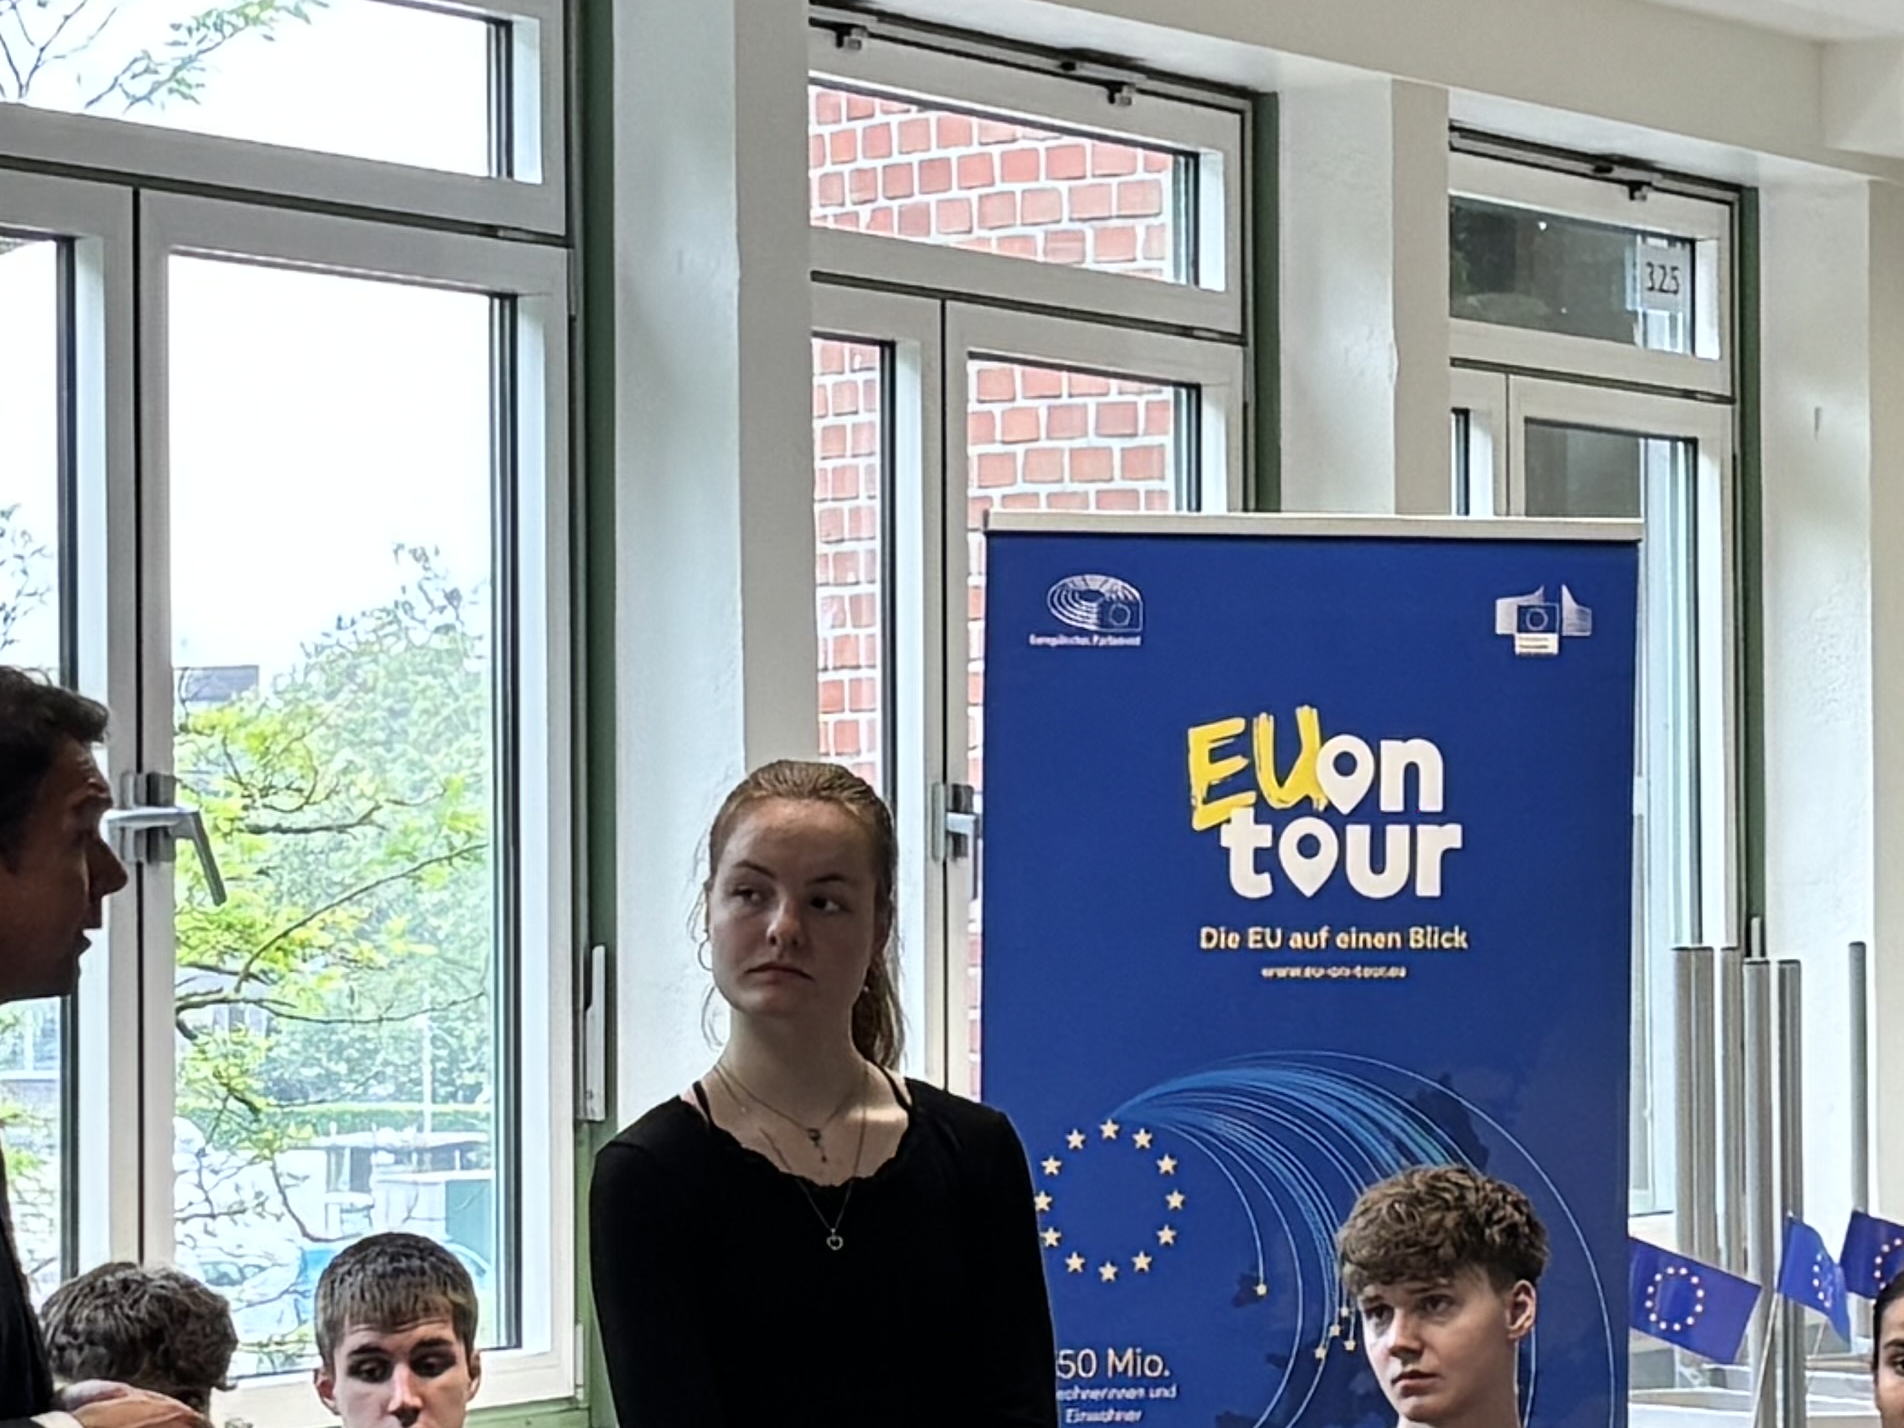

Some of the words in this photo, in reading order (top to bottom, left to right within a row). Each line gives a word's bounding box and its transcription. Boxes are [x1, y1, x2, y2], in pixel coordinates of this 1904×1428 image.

[1188, 705, 1327, 830] EU
[1315, 734, 1443, 815] on
[1220, 807, 1462, 897] tour
[1200, 926, 1240, 949] Die
[1248, 926, 1282, 949] EU
[1289, 925, 1330, 949] auf
[1336, 926, 1402, 949] einen
[1408, 925, 1468, 949] Blick
[1056, 1348, 1097, 1379] 50
[1107, 1347, 1171, 1378] Mio.
[1149, 1384, 1177, 1398] und
